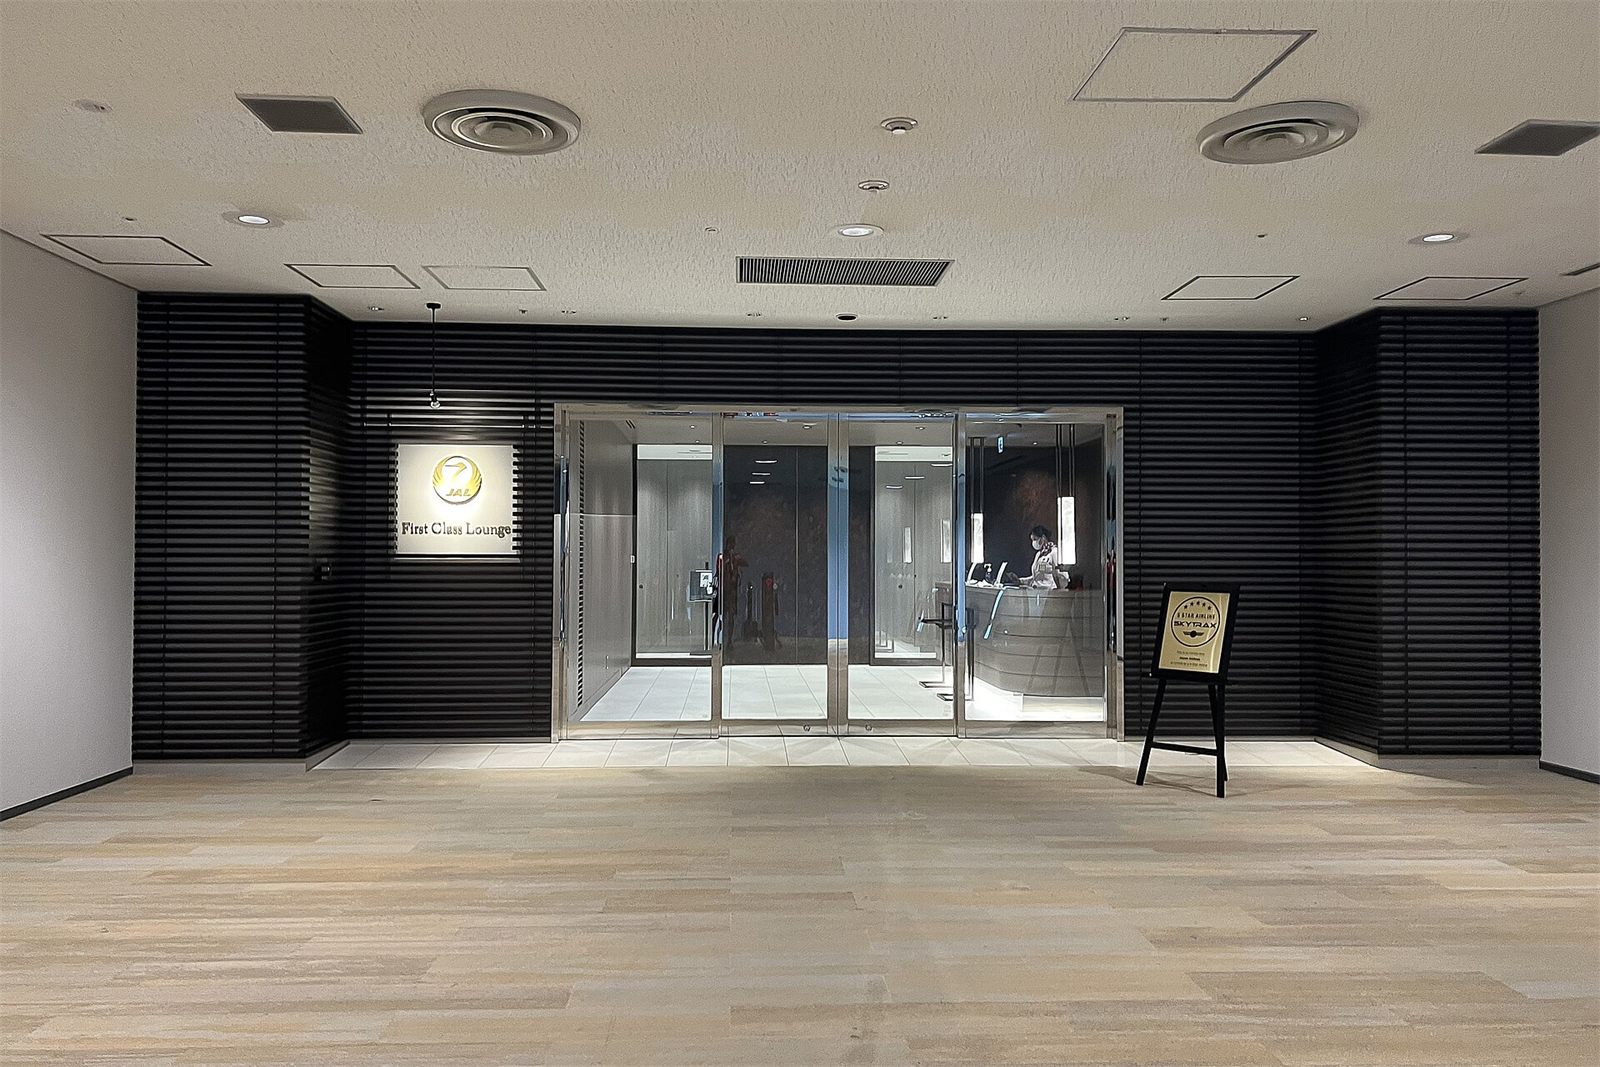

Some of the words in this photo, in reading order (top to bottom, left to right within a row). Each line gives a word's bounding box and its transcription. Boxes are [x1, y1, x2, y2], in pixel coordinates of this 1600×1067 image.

[446, 488, 471, 497] JAL
[401, 522, 428, 535] First
[431, 522, 463, 535] Class
[466, 522, 512, 539] Lounge
[1173, 620, 1217, 629] SKYTRAX
